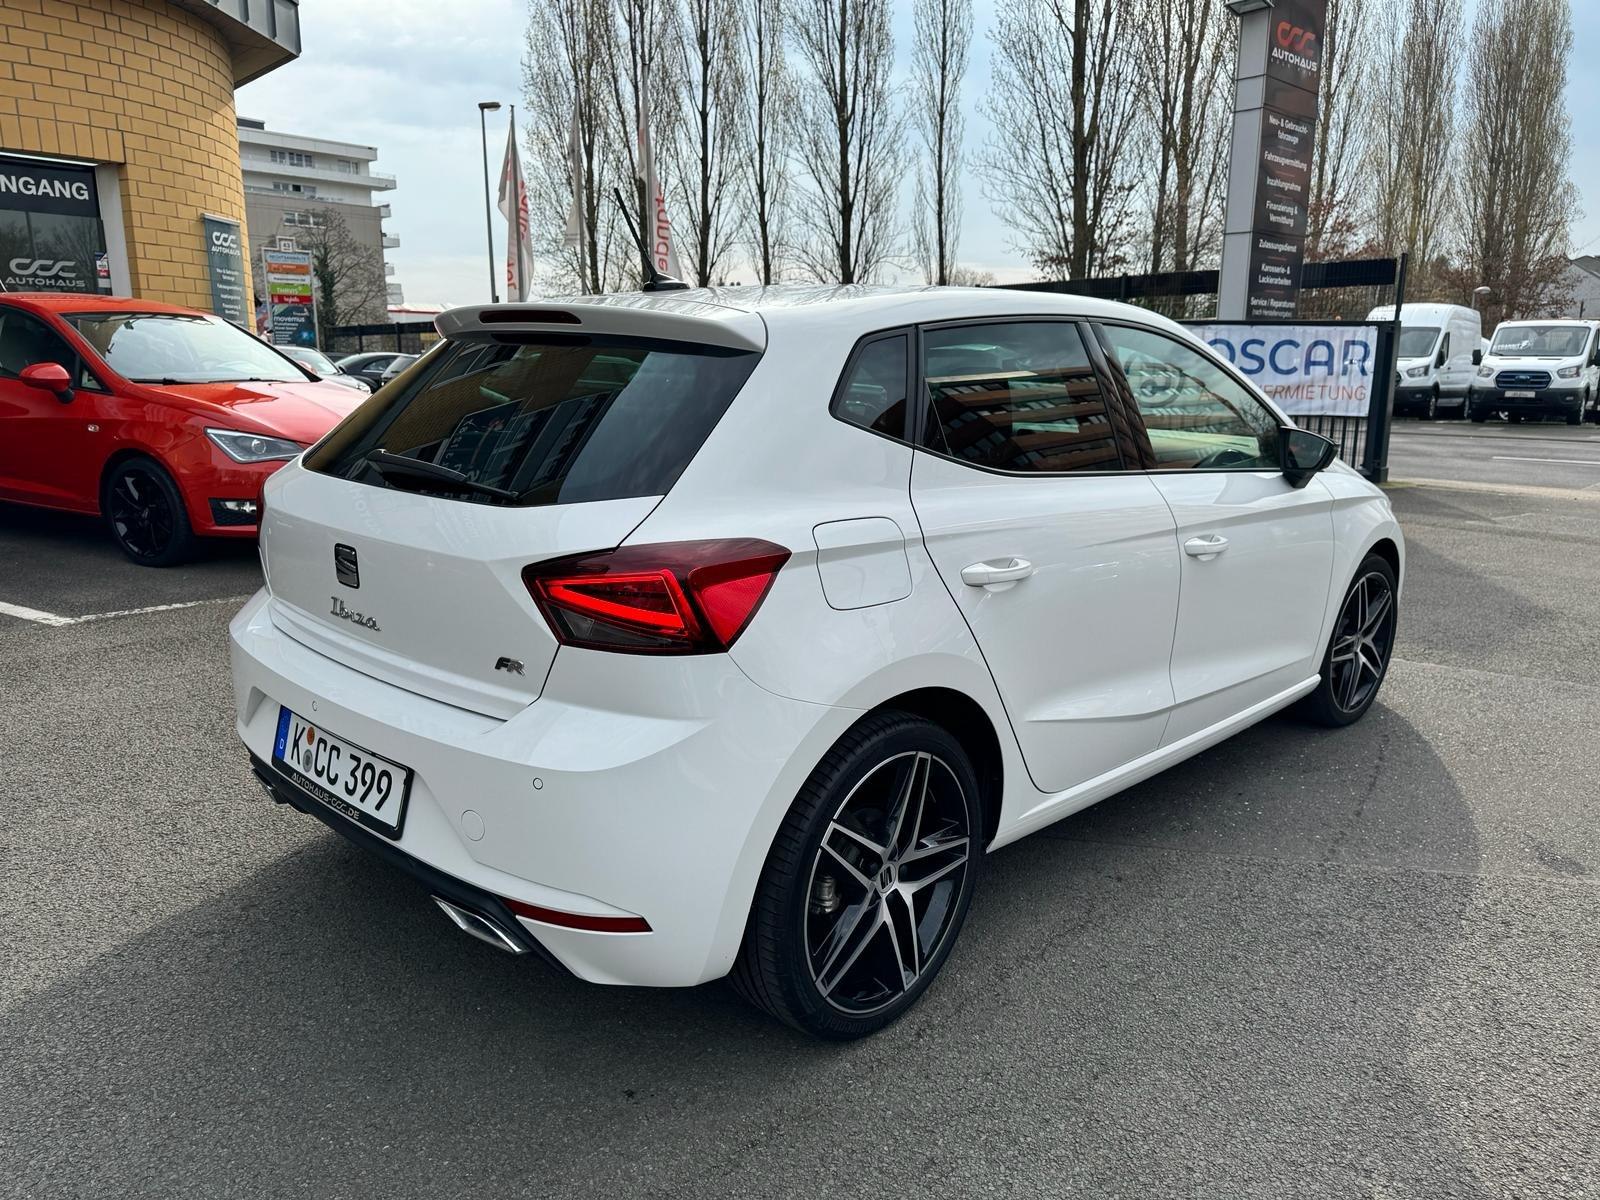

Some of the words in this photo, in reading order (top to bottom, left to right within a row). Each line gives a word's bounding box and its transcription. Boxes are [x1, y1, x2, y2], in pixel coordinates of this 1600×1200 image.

[1271, 47, 1317, 71] AUTOHAUS
[0, 174, 89, 200] NGANG
[211, 245, 241, 256] AUTOHAUS
[5, 277, 85, 287] AUTOHAUS
[1250, 296, 1267, 307] Service
[1207, 338, 1371, 376] OSCAR
[1261, 384, 1367, 401] ERMIETUNG
[330, 596, 382, 631] Ibiza
[495, 656, 525, 677] FR
[279, 738, 285, 749] D
[291, 722, 306, 765] K
[314, 737, 341, 786] CC
[345, 753, 393, 812] 399
